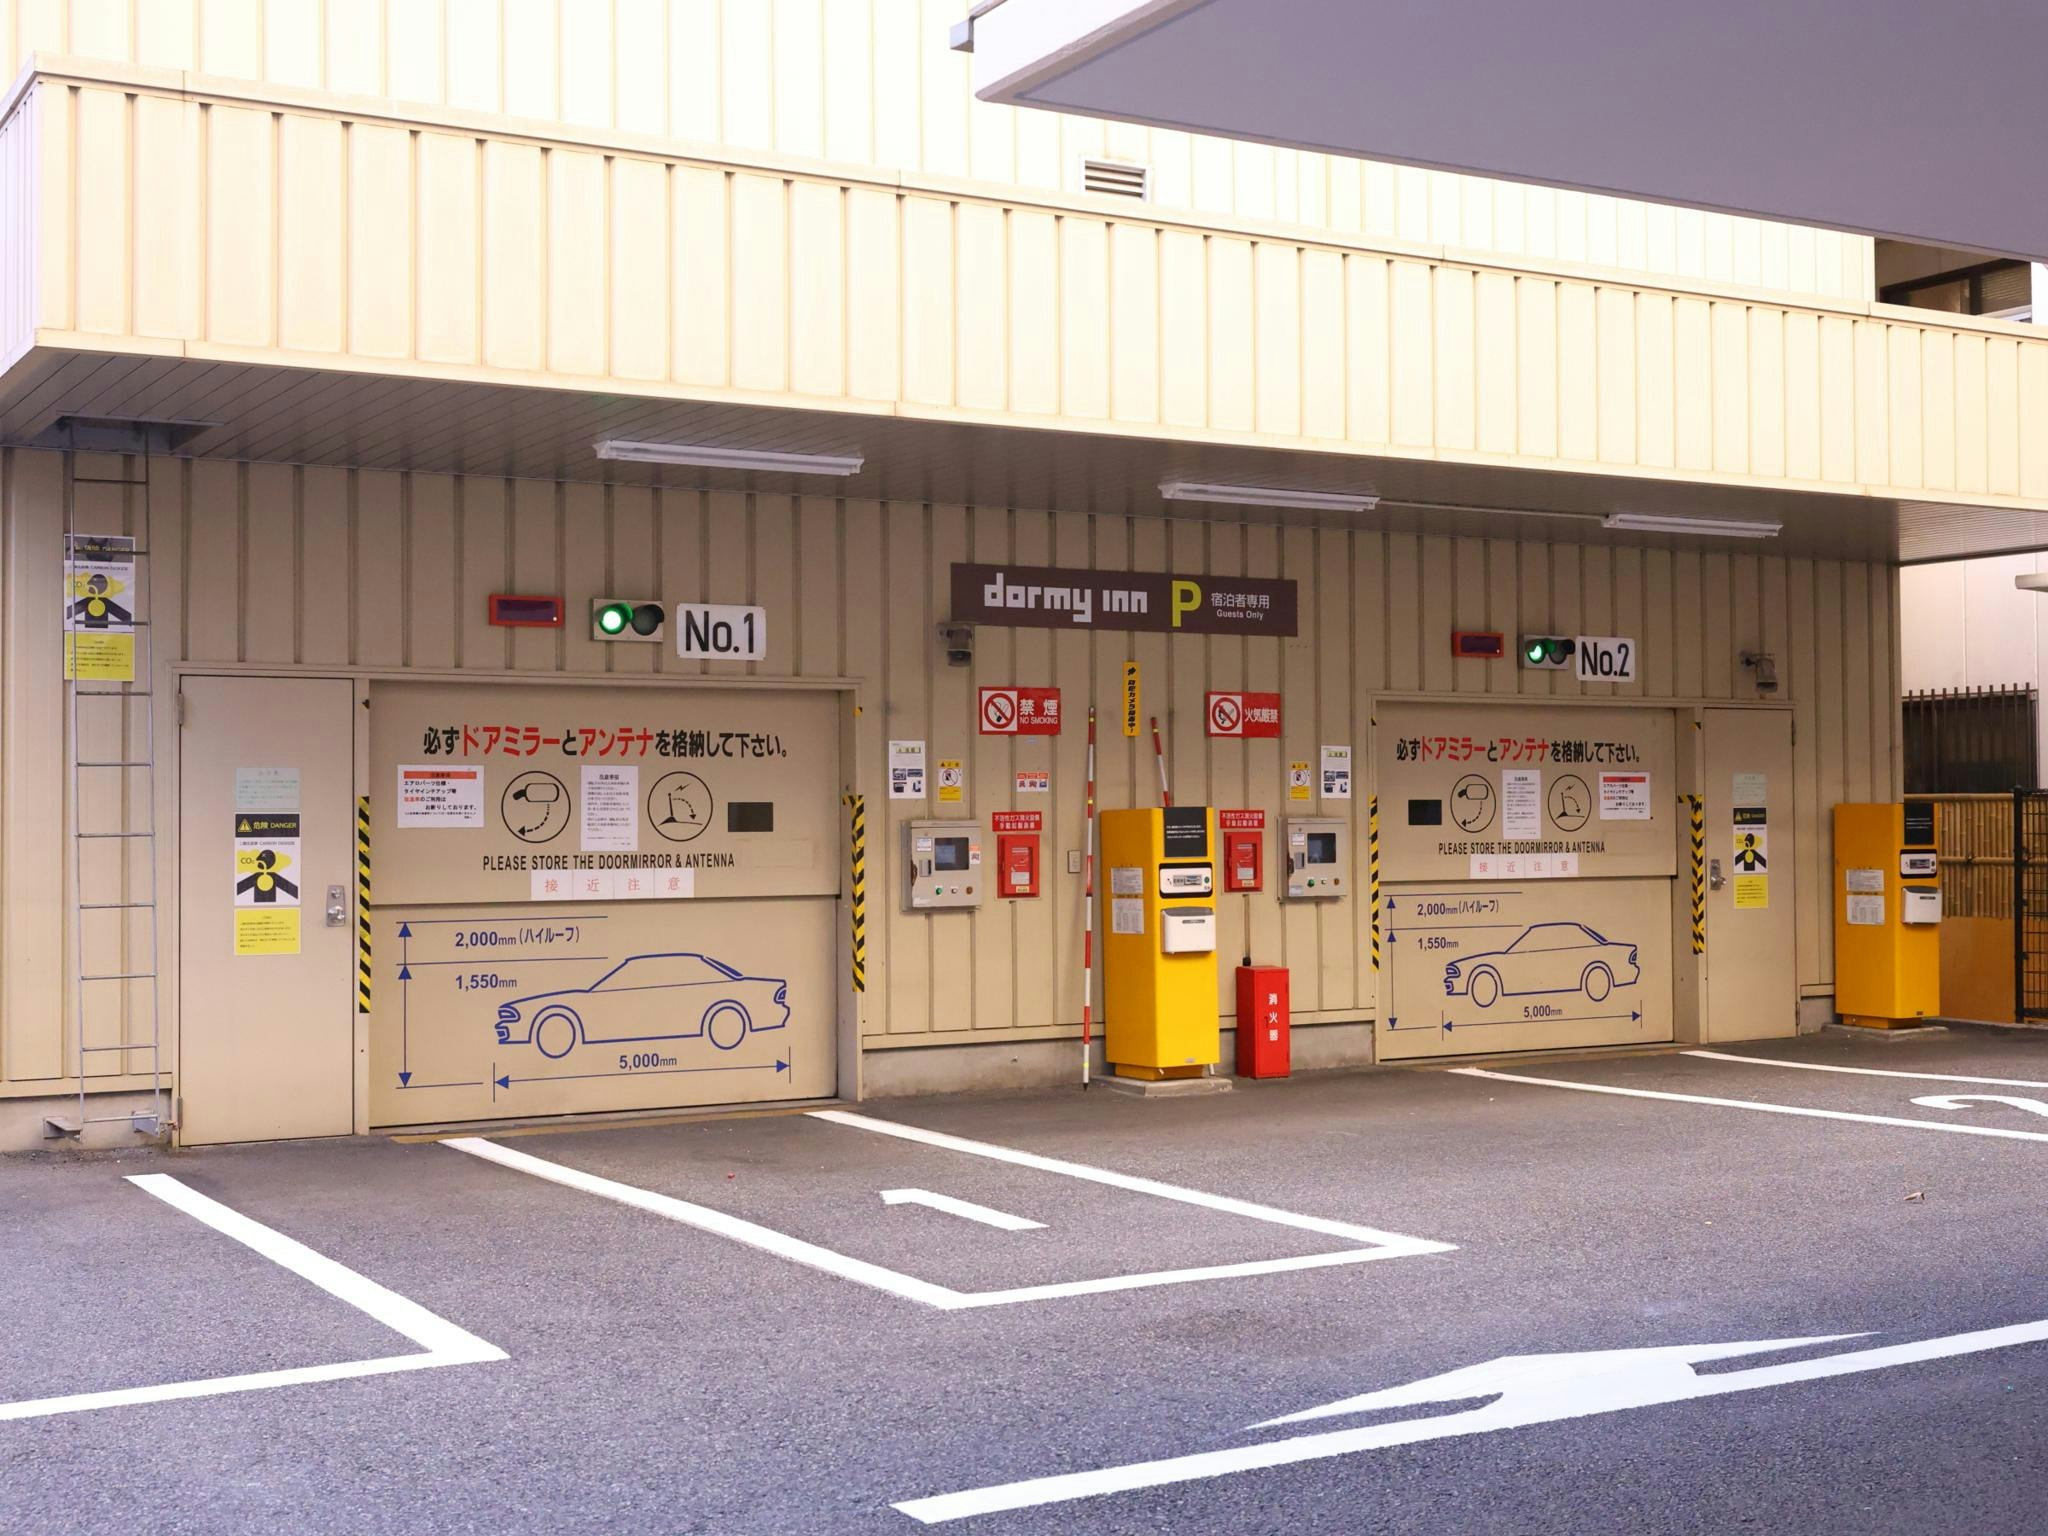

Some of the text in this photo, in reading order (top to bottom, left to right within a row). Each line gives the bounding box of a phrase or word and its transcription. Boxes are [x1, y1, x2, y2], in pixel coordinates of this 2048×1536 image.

[984, 572, 1148, 623] dormy inn
[1172, 580, 1202, 627] P
[1211, 592, 1270, 609] 宿泊者専用
[1216, 609, 1264, 621] Guests Only
[685, 610, 754, 653] No.1
[1581, 641, 1630, 677] No.2
[1020, 698, 1058, 716] 禁煙
[1244, 707, 1279, 724] 火気厳禁
[1020, 716, 1058, 725] NO SMOKING
[423, 723, 789, 759] 必ずドアミラーとアンテナを格納して下さい。
[1396, 736, 1640, 763] 必ずドアミラーとアンテナを格納して下さい。
[1438, 841, 1605, 855] PLEASE STORE THE DOORMIRROR & ANTENNA
[483, 853, 735, 870] PLEASE STORE THE DOORMIRROR & ANTENNA
[1479, 860, 1569, 873] 接近注意
[544, 877, 681, 893] 接近注意
[1418, 937, 1459, 950] 1,550mm
[455, 974, 517, 991] 1,550mm
[1268, 993, 1279, 1042] 消火器
[1523, 1006, 1562, 1019] 5,000mm
[619, 1053, 677, 1071] 5,000mm
